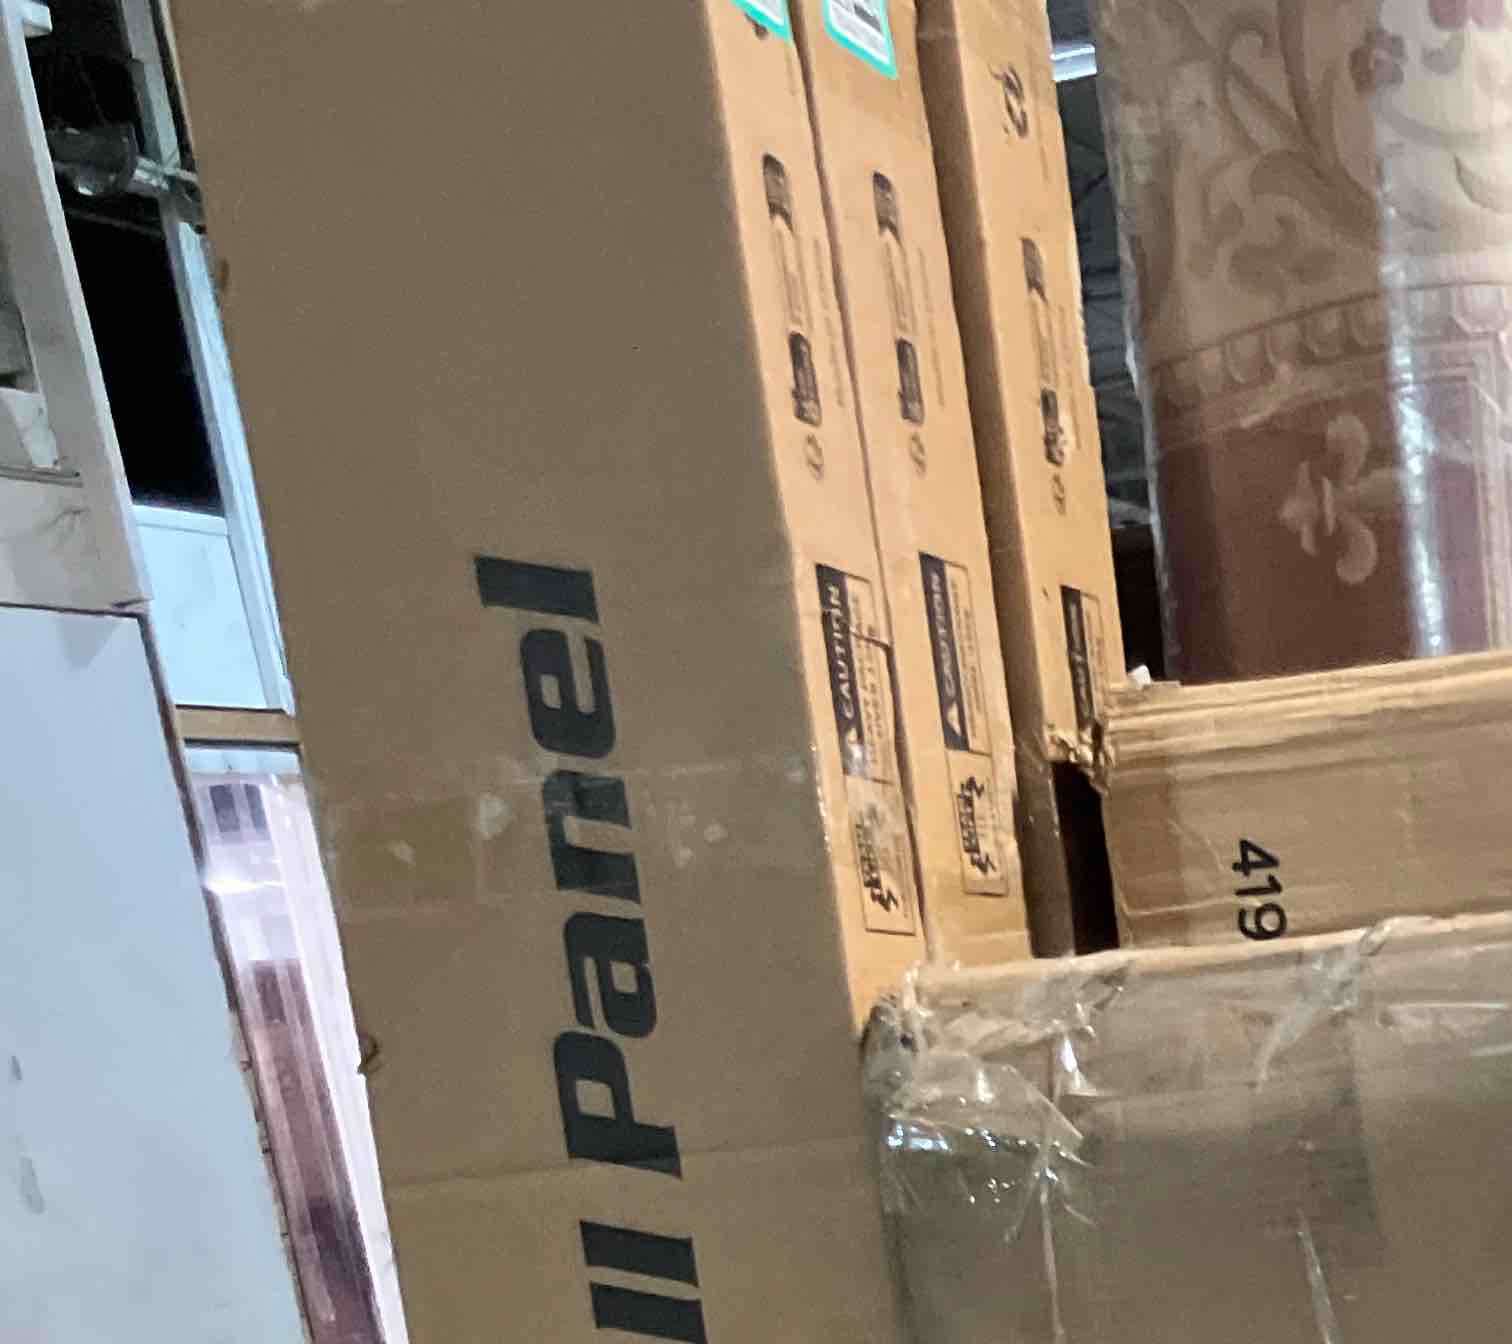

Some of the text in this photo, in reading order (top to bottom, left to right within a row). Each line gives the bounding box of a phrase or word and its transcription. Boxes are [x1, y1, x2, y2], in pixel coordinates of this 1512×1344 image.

[829, 584, 855, 719] CAUTION
[931, 572, 957, 704] CAUTION
[473, 553, 683, 1180] Panel
[1231, 838, 1288, 940] 419
